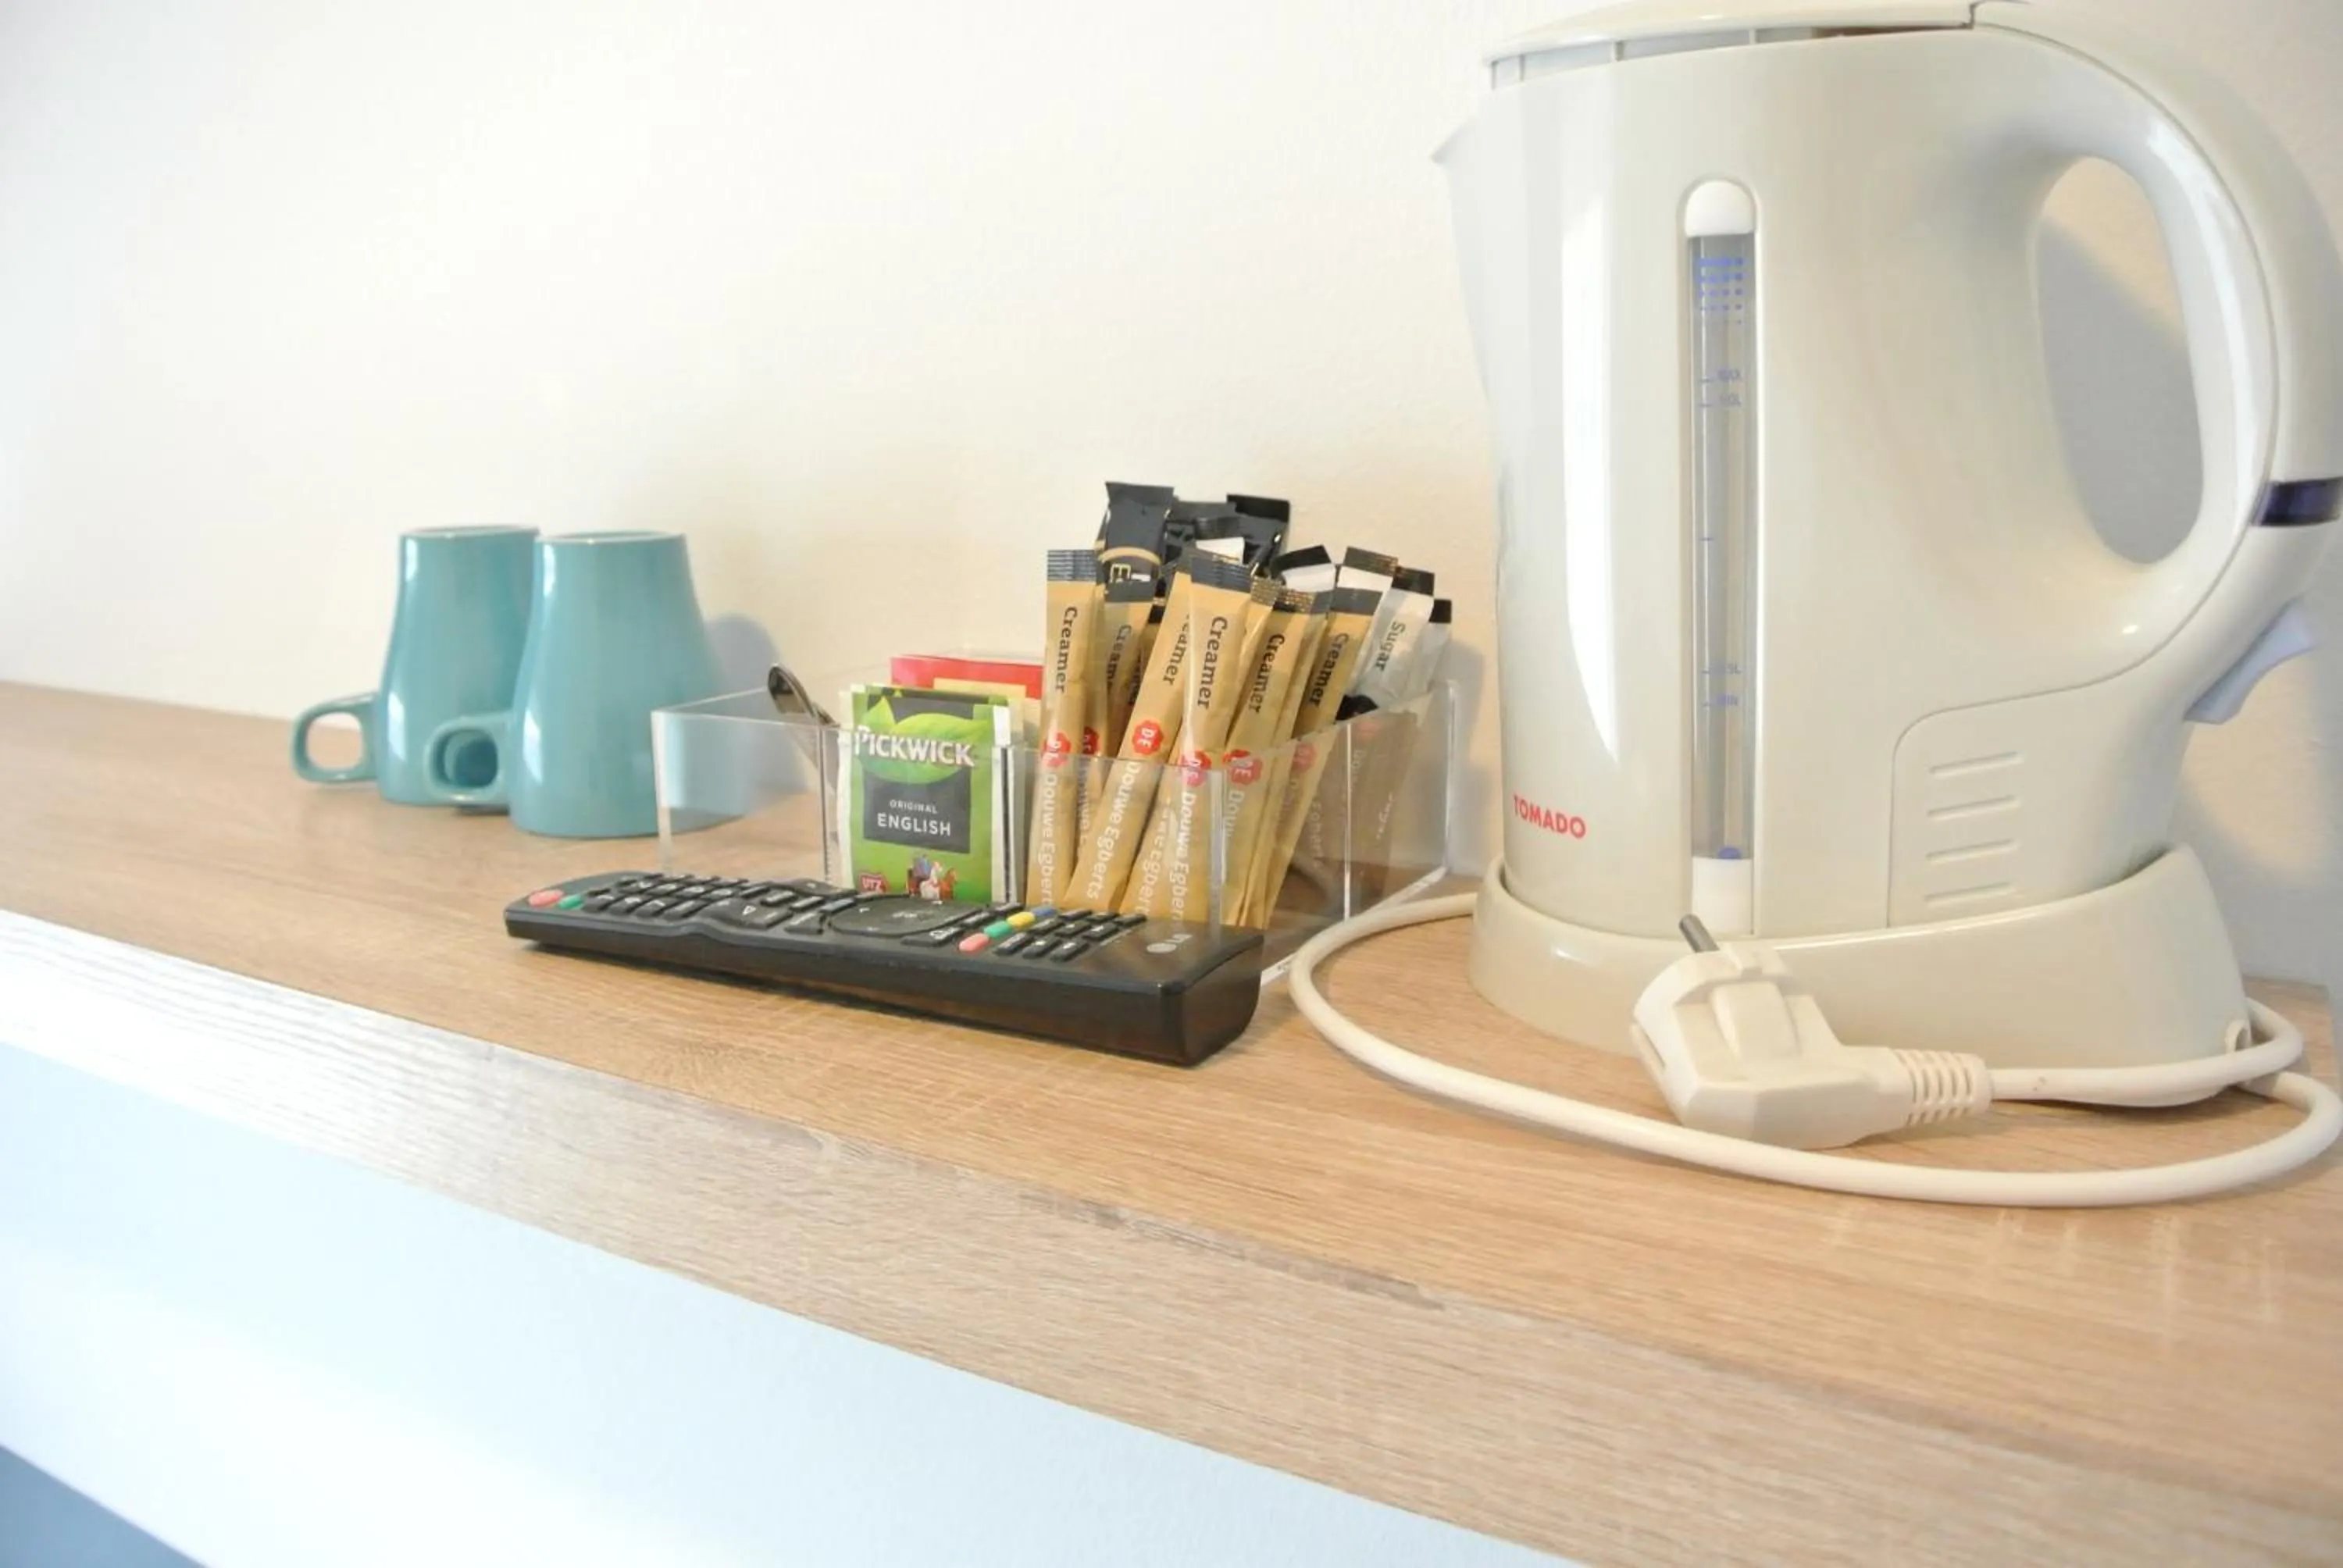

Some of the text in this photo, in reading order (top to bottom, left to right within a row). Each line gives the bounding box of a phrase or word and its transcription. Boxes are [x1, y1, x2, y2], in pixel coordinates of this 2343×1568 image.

[1055, 605, 1078, 693] Creamer
[1107, 624, 1132, 688] Cream
[1163, 614, 1190, 686] eamer
[1197, 615, 1228, 710] Creamer
[1249, 633, 1286, 715] Creamer
[1310, 633, 1350, 708] Creamer
[1375, 621, 1406, 672] Sugar
[854, 725, 975, 767] PICKWICK
[877, 812, 951, 836] ENGLISH
[890, 799, 938, 814] ORIGINAL
[1109, 761, 1142, 825] Douwe
[1224, 789, 1245, 837] Dou
[1513, 793, 1586, 839] TOMADO
[1038, 773, 1057, 905] Douwe Egbert
[1086, 825, 1121, 900] Egberts
[1169, 790, 1196, 921] Douwe Egber
[862, 876, 883, 891] UTZ
[1135, 849, 1164, 916] Egbert
